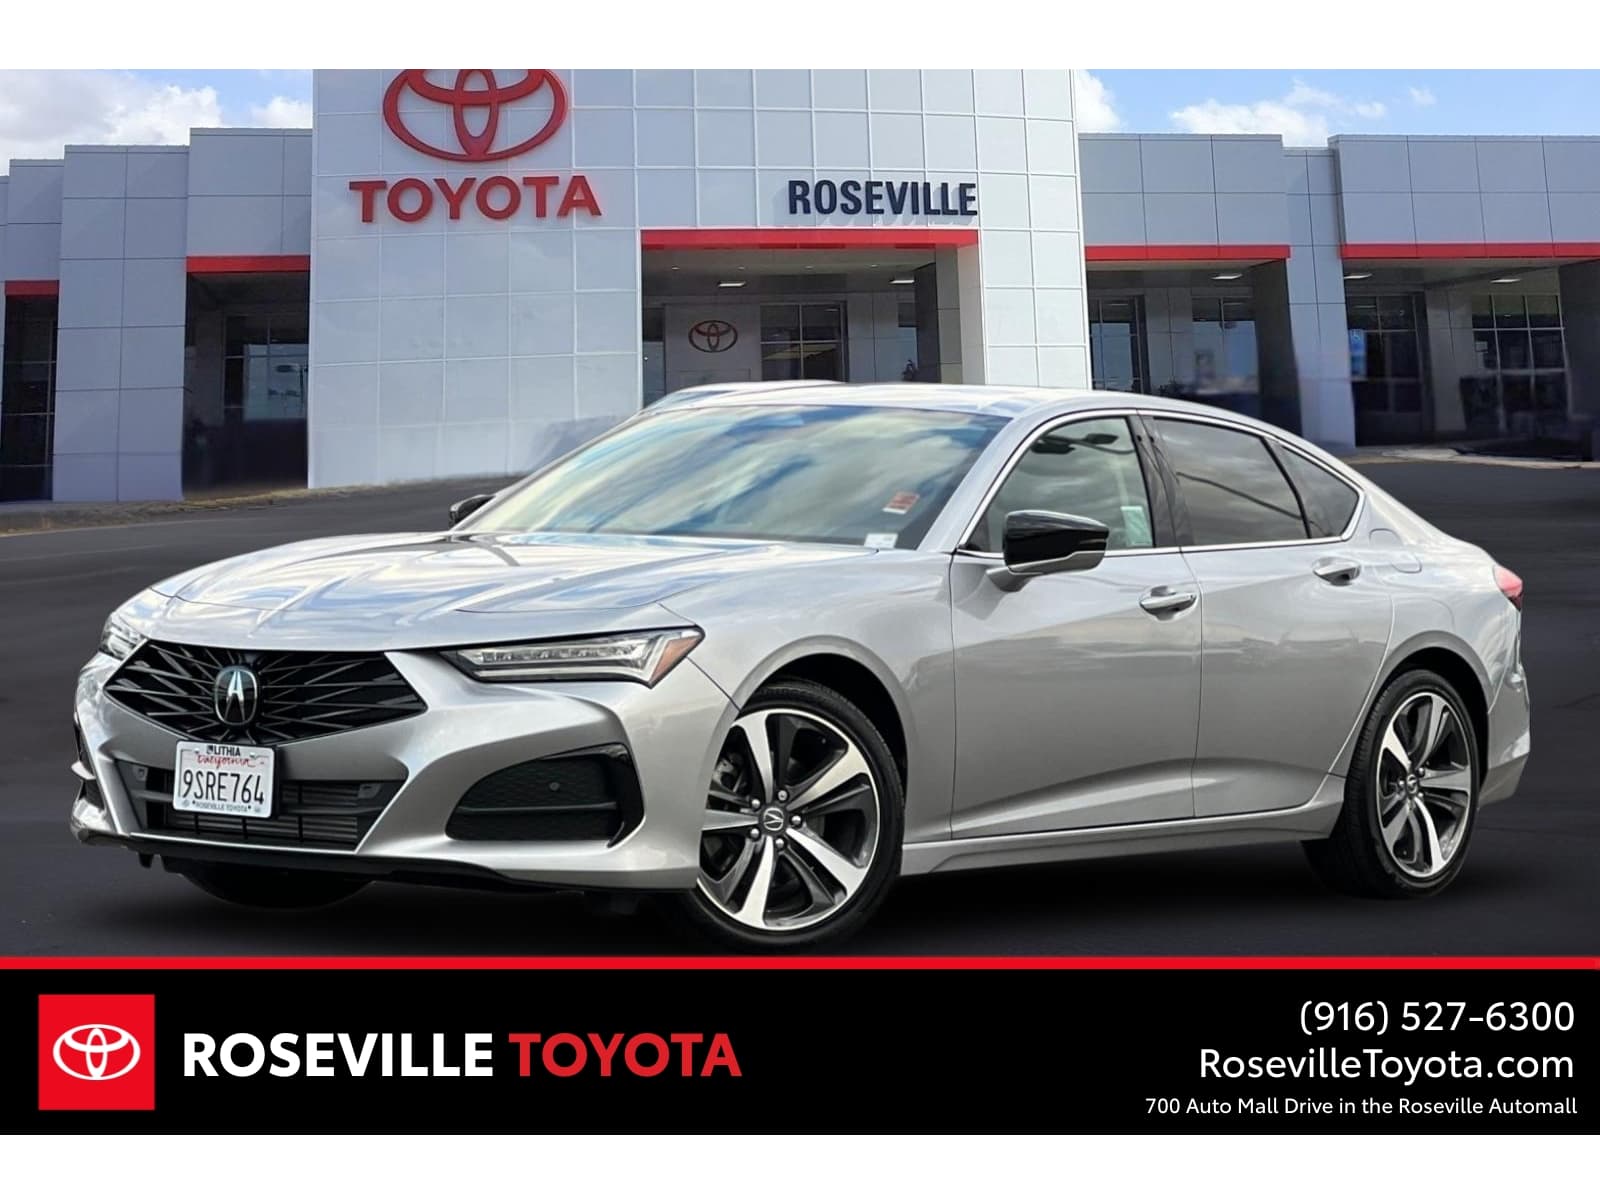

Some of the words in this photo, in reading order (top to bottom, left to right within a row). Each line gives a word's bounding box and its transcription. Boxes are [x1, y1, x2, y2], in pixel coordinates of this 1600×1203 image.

[349, 175, 602, 223] TOYOTA
[788, 180, 978, 217] ROSEVILLE
[214, 745, 241, 756] LITHIA
[182, 769, 264, 804] 9SRE764
[195, 801, 225, 810] ROSEVILLE
[226, 804, 248, 812] TOYOTA
